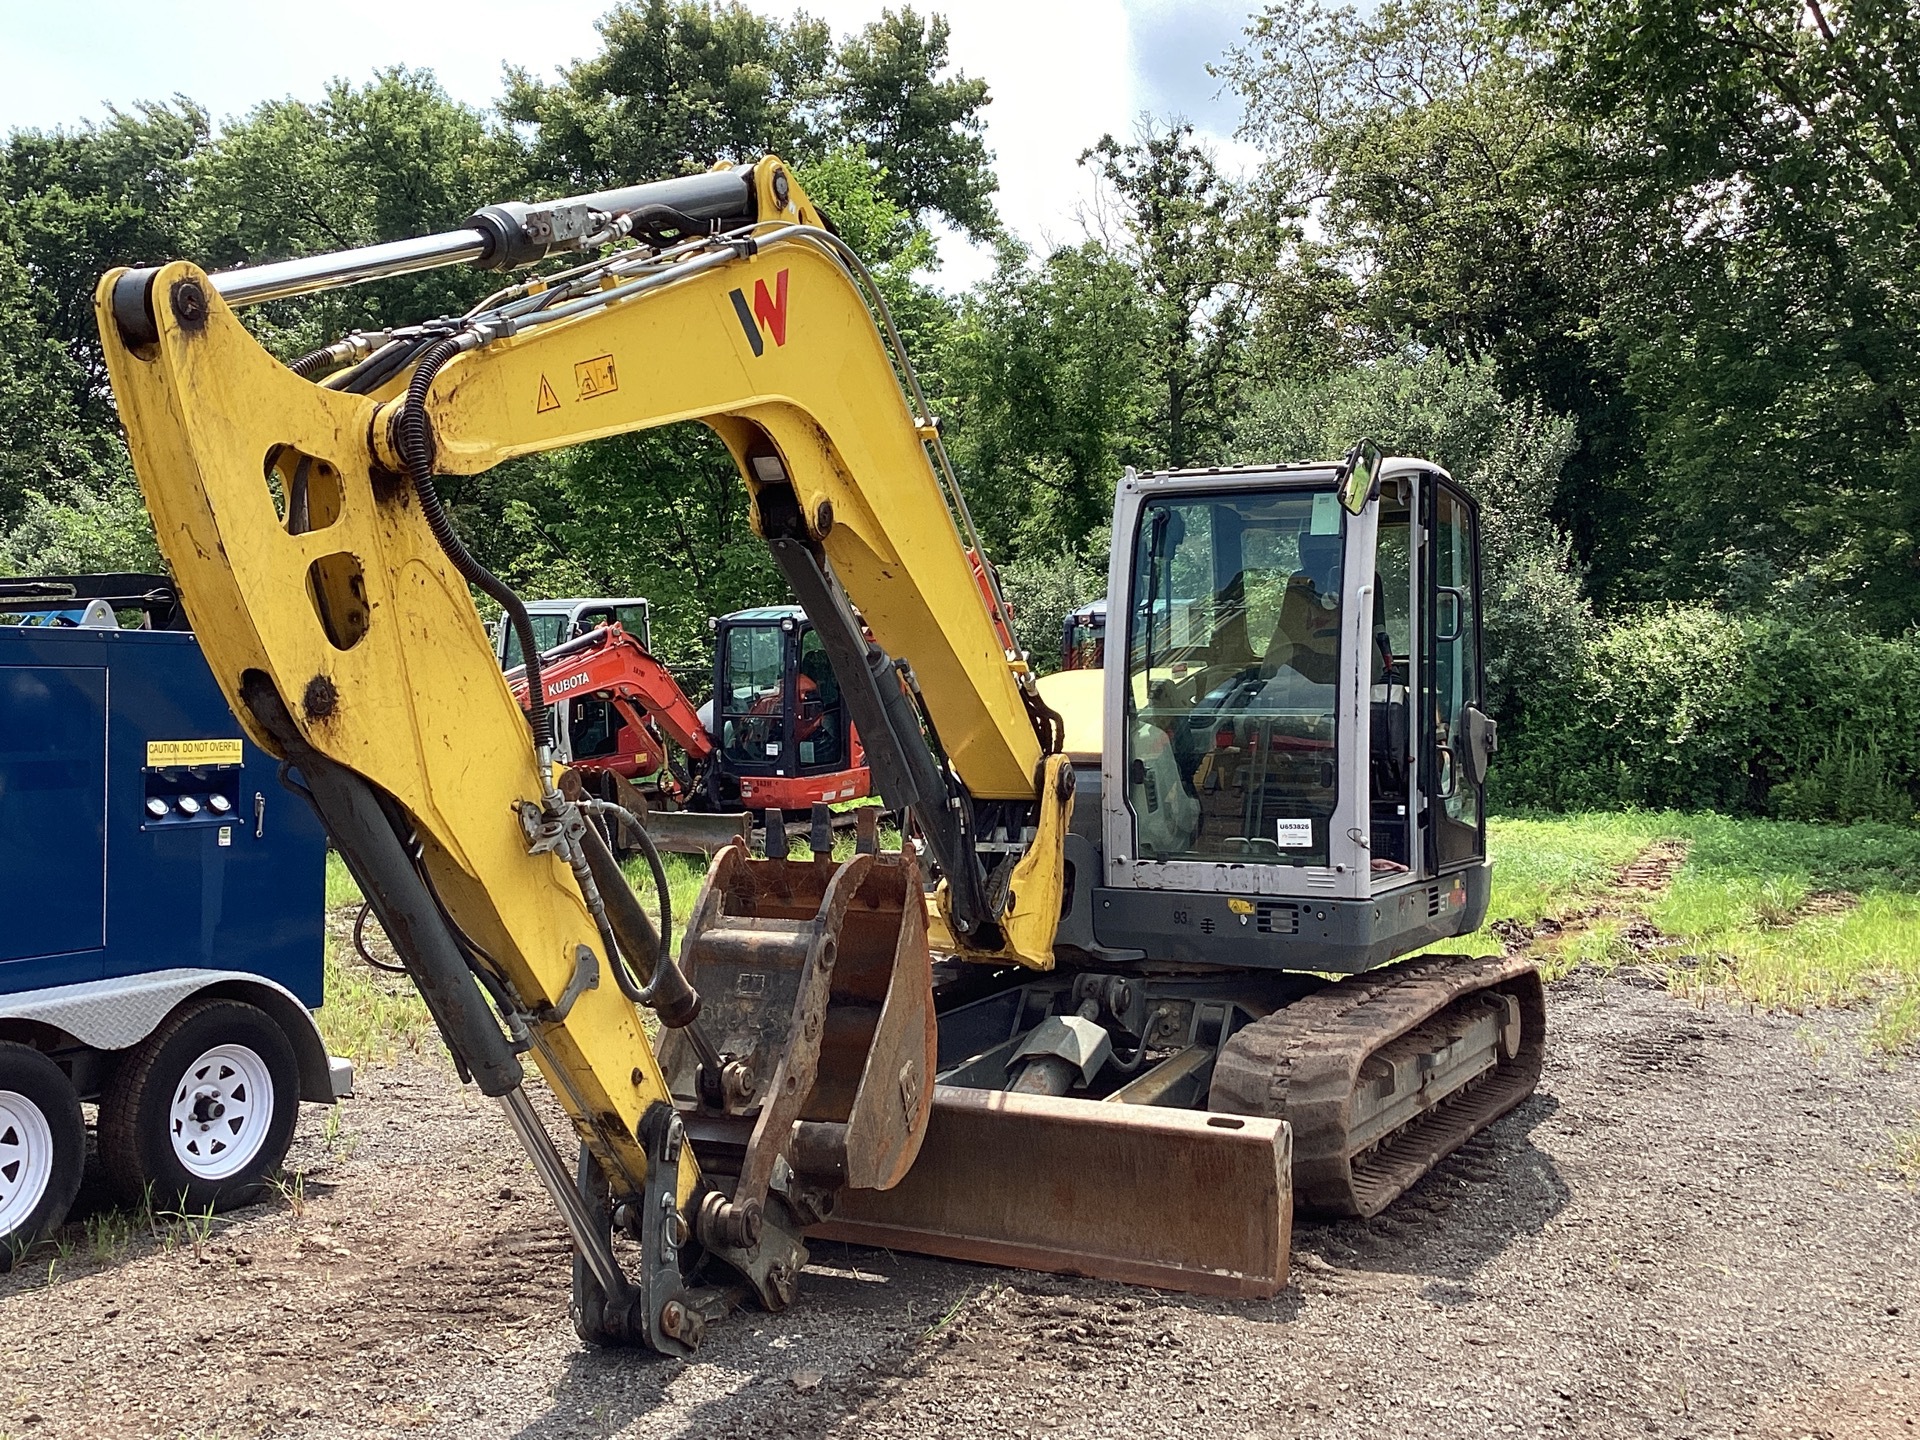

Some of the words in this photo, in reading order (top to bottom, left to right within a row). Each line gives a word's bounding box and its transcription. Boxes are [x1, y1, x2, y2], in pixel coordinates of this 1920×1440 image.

[548, 672, 590, 696] KUBOTA
[149, 743, 179, 753] CAUTION
[182, 743, 193, 752] DO
[195, 742, 208, 752] NOT
[210, 741, 240, 751] OVERFILL
